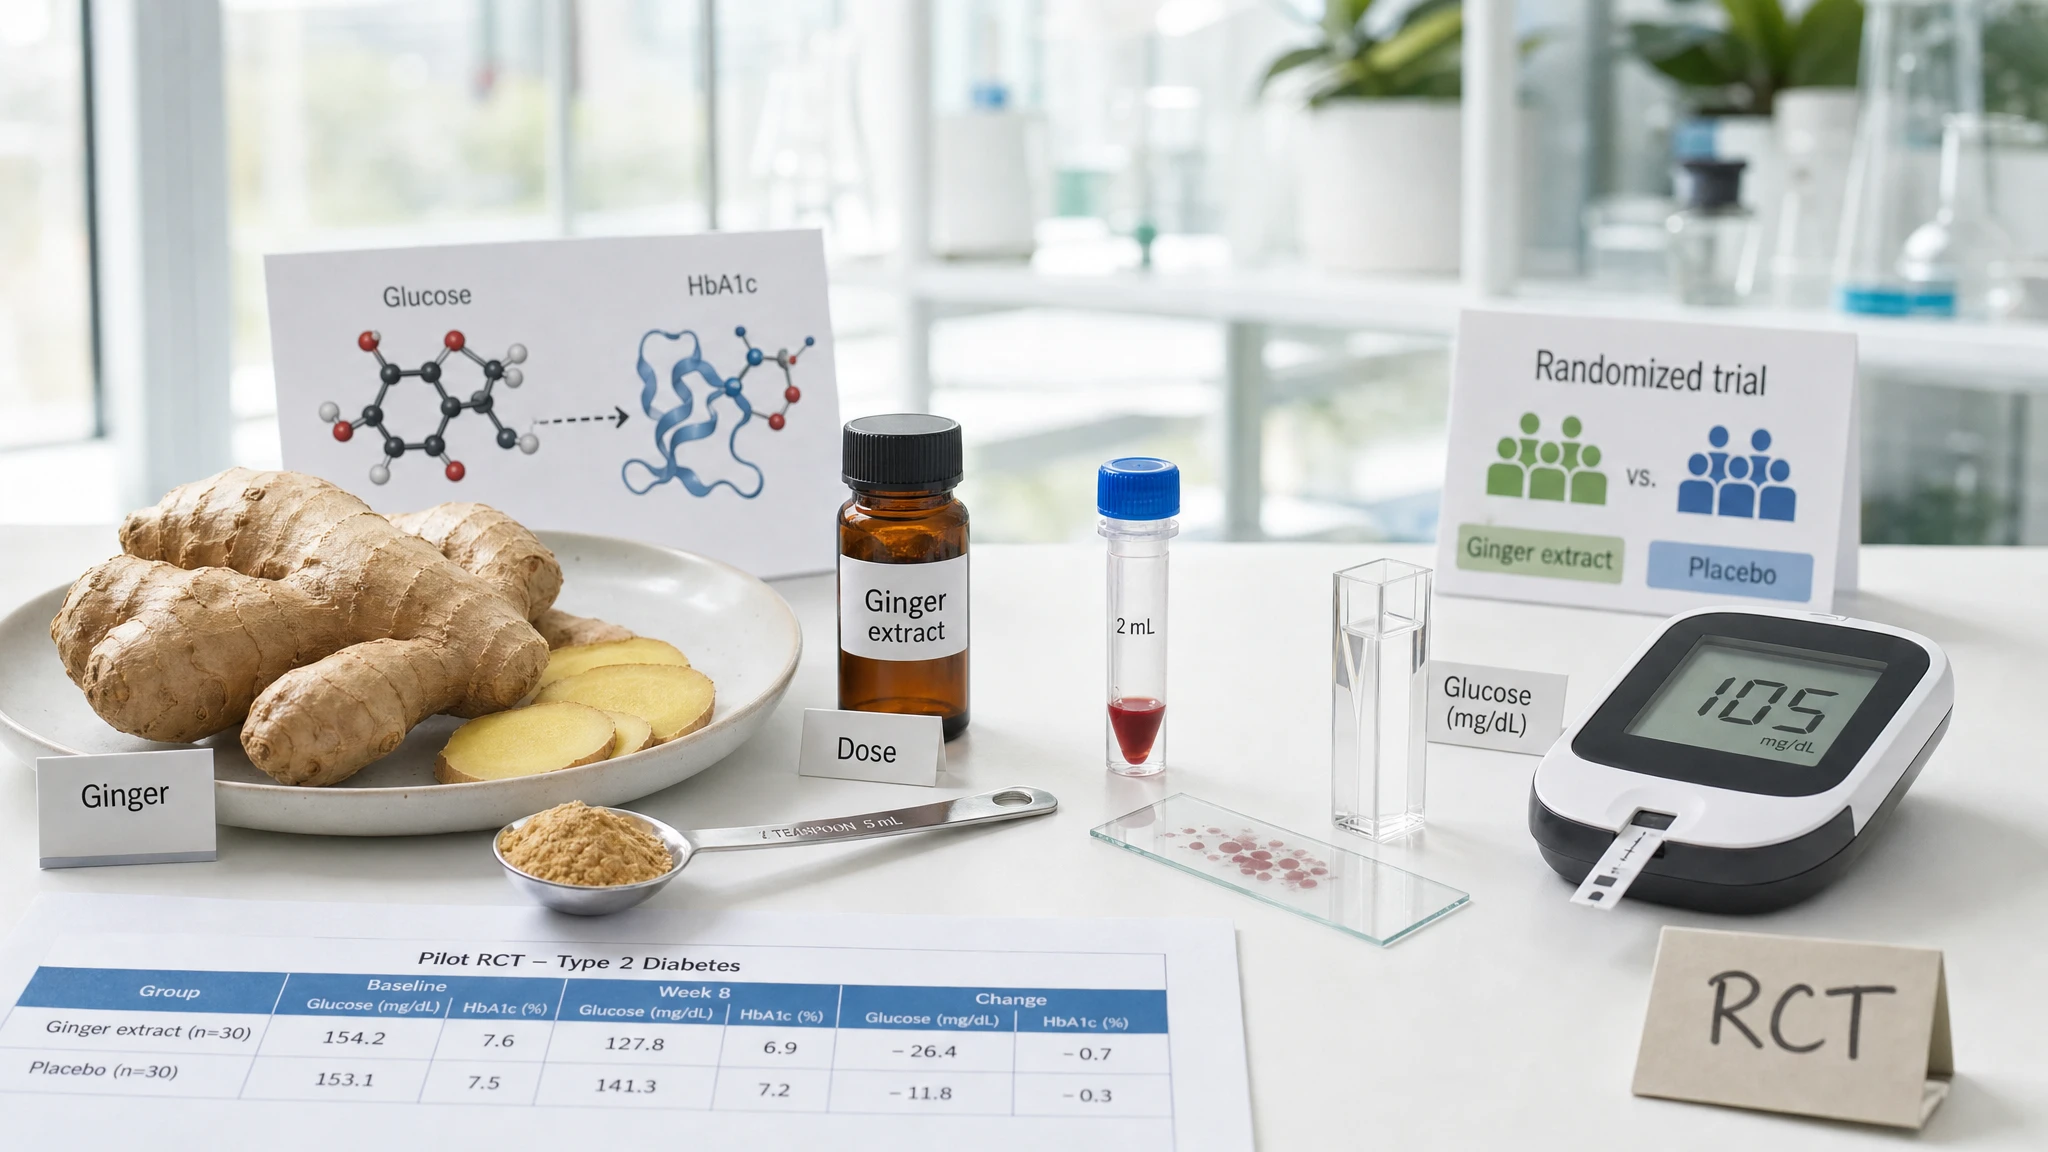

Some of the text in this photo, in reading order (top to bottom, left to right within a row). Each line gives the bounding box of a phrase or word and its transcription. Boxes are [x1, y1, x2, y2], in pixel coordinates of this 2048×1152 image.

[687, 274, 758, 296] HbA1c
[383, 285, 472, 308] Glucose
[1536, 349, 1767, 396] Randomized trial
[1626, 469, 1656, 487] vs.
[1466, 535, 1613, 570] Ginger extract
[1689, 556, 1777, 585] Placebo
[865, 588, 947, 620] Ginger
[868, 621, 946, 643] extract
[1116, 617, 1156, 635] 2 mL
[1444, 675, 1532, 708] Glucose
[1696, 676, 1839, 735] 105
[1446, 705, 1527, 739] (mg/dL)
[837, 736, 897, 764] Dose
[1759, 735, 1815, 754] mg/dL
[81, 783, 170, 813] Ginger
[863, 818, 875, 829] 5
[877, 816, 903, 827] mL
[418, 951, 470, 966] Pilot
[476, 953, 527, 967] RCT
[557, 954, 610, 972] Type
[619, 956, 634, 970] 2
[642, 956, 741, 973] Diabetes
[139, 984, 201, 1001] Group
[366, 979, 448, 993] Baseline
[659, 985, 731, 999] Week 8
[306, 998, 441, 1015] Glucose (mg/dL)
[975, 992, 1048, 1008] Change
[462, 1001, 548, 1017] HbA1c (%)
[579, 1004, 714, 1021] Glucose (mg/dL)
[740, 1008, 824, 1024] HbA1c (%)
[1707, 969, 1897, 1061] RCT
[865, 1011, 1000, 1029] Glucose (mg/dL)
[1043, 1015, 1129, 1031] HbA1c (%)
[46, 1020, 252, 1042] Ginger extract (n=30)
[323, 1030, 386, 1045] 154.2
[483, 1034, 515, 1048] 7.6
[605, 1037, 665, 1051] 127.8
[763, 1041, 798, 1055] 6.9
[910, 1044, 957, 1058] 26.4
[1079, 1047, 1112, 1061] 0.7
[28, 1061, 178, 1081] Placebo (n=30)
[316, 1072, 373, 1087] 153.1
[469, 1075, 500, 1090] 7.5
[598, 1078, 657, 1093] 141.3
[760, 1083, 790, 1097] 7.2
[910, 1086, 952, 1100] 11.8
[1079, 1089, 1112, 1103] 0.3
